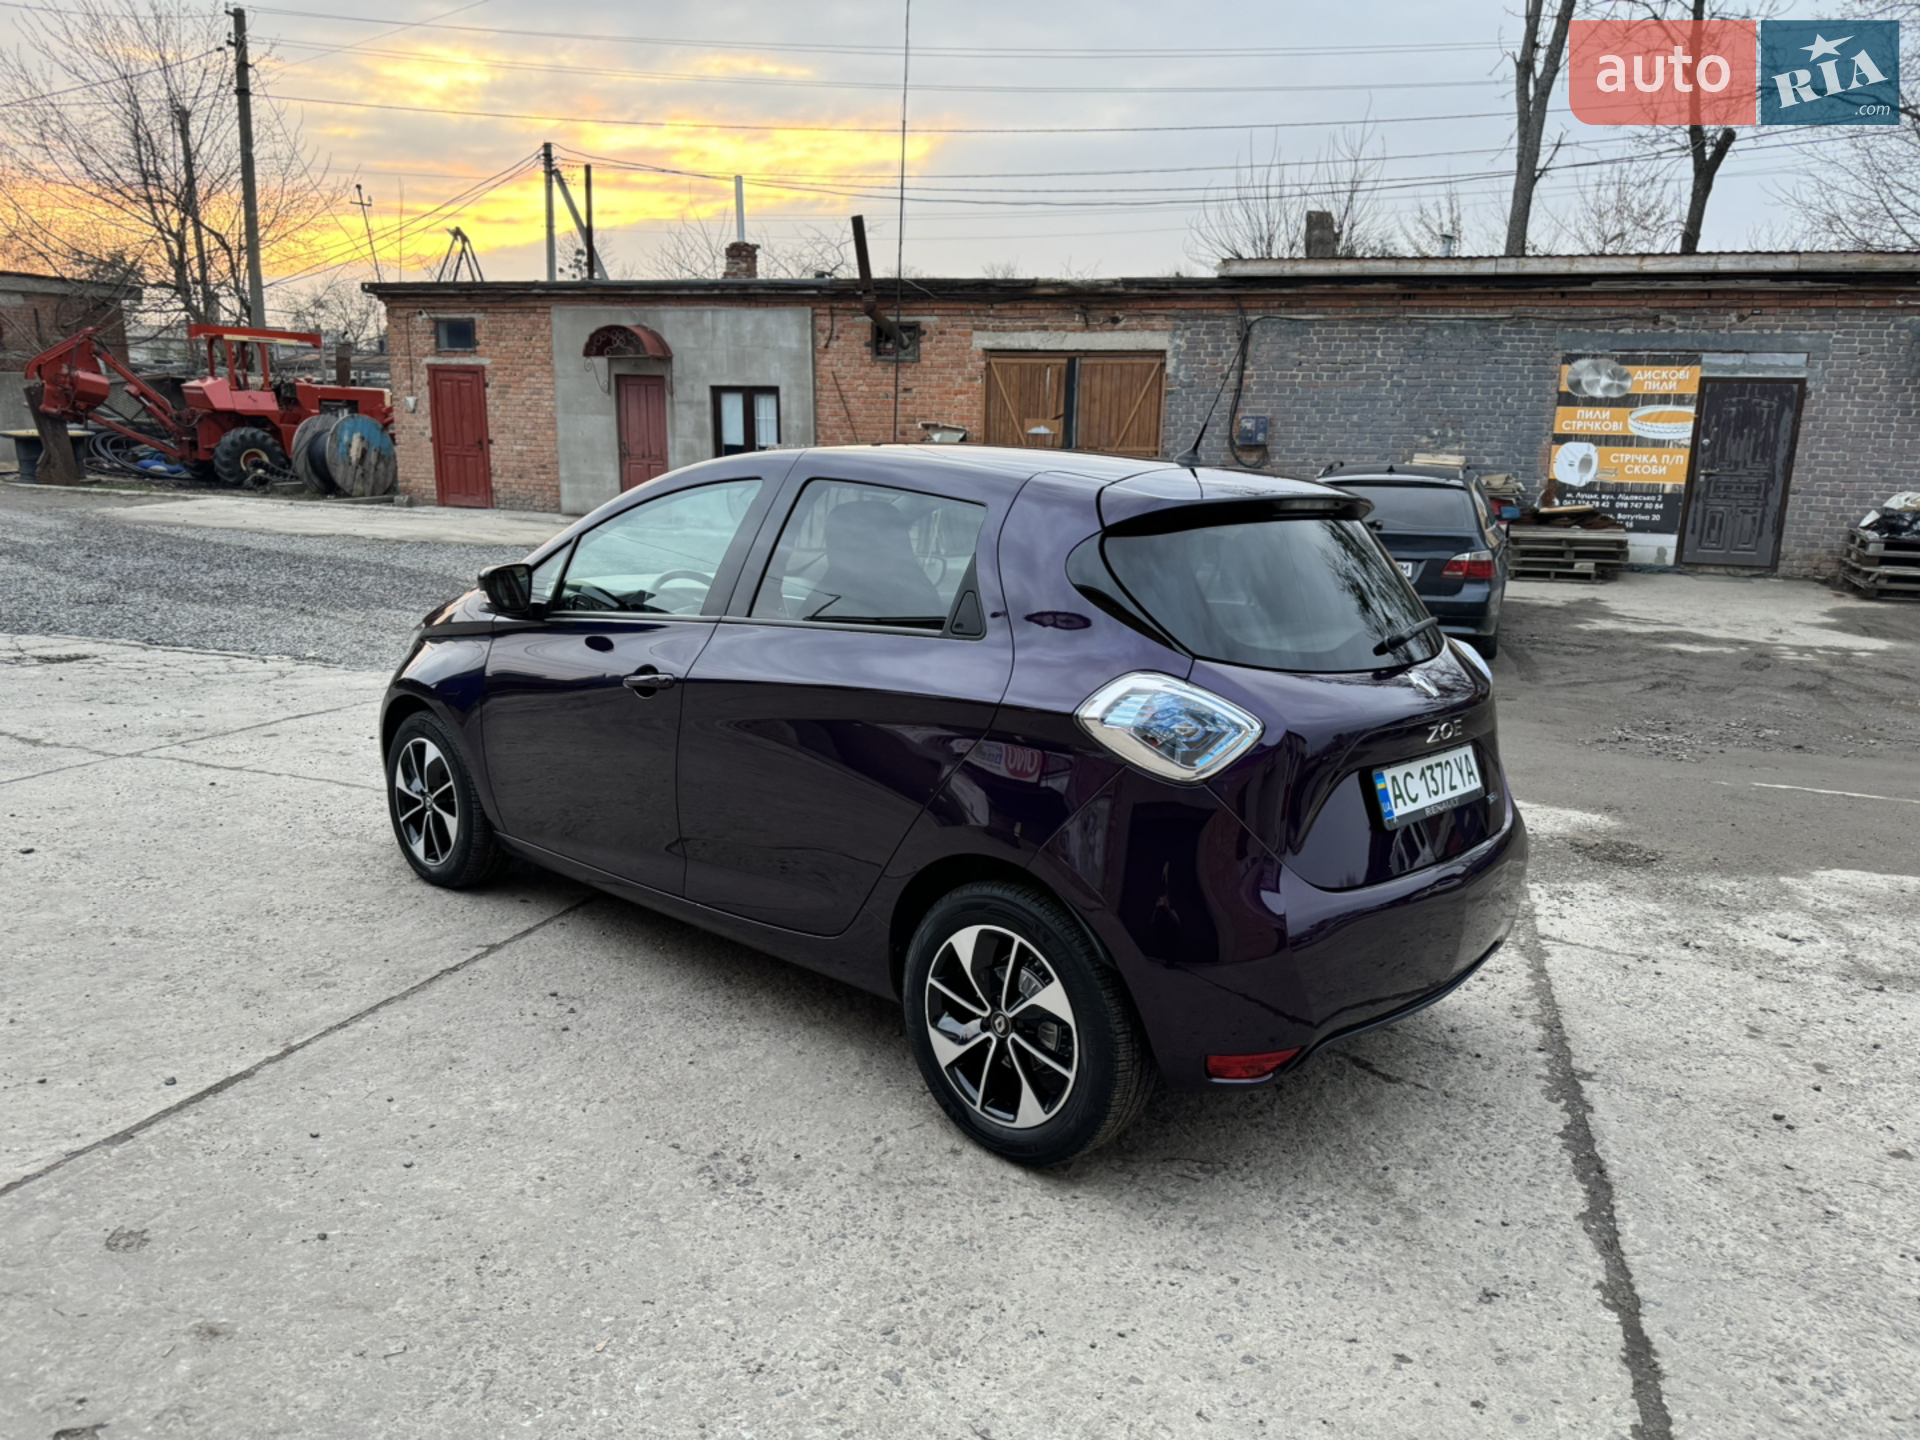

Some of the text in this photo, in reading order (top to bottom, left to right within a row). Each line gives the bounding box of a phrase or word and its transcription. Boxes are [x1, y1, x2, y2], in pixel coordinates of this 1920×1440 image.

[1633, 369, 1690, 381] ДИСКОВІ
[1643, 380, 1677, 391] ПИЛИ
[1576, 410, 1610, 420] ПИЛИ
[1561, 420, 1623, 431] СТРІЧКОВІ
[1610, 453, 1684, 465] СТРІЧКА П/П
[1624, 464, 1667, 475] СКОБИ
[1426, 719, 1463, 744] ZOE
[1425, 798, 1460, 816] RENAULT
